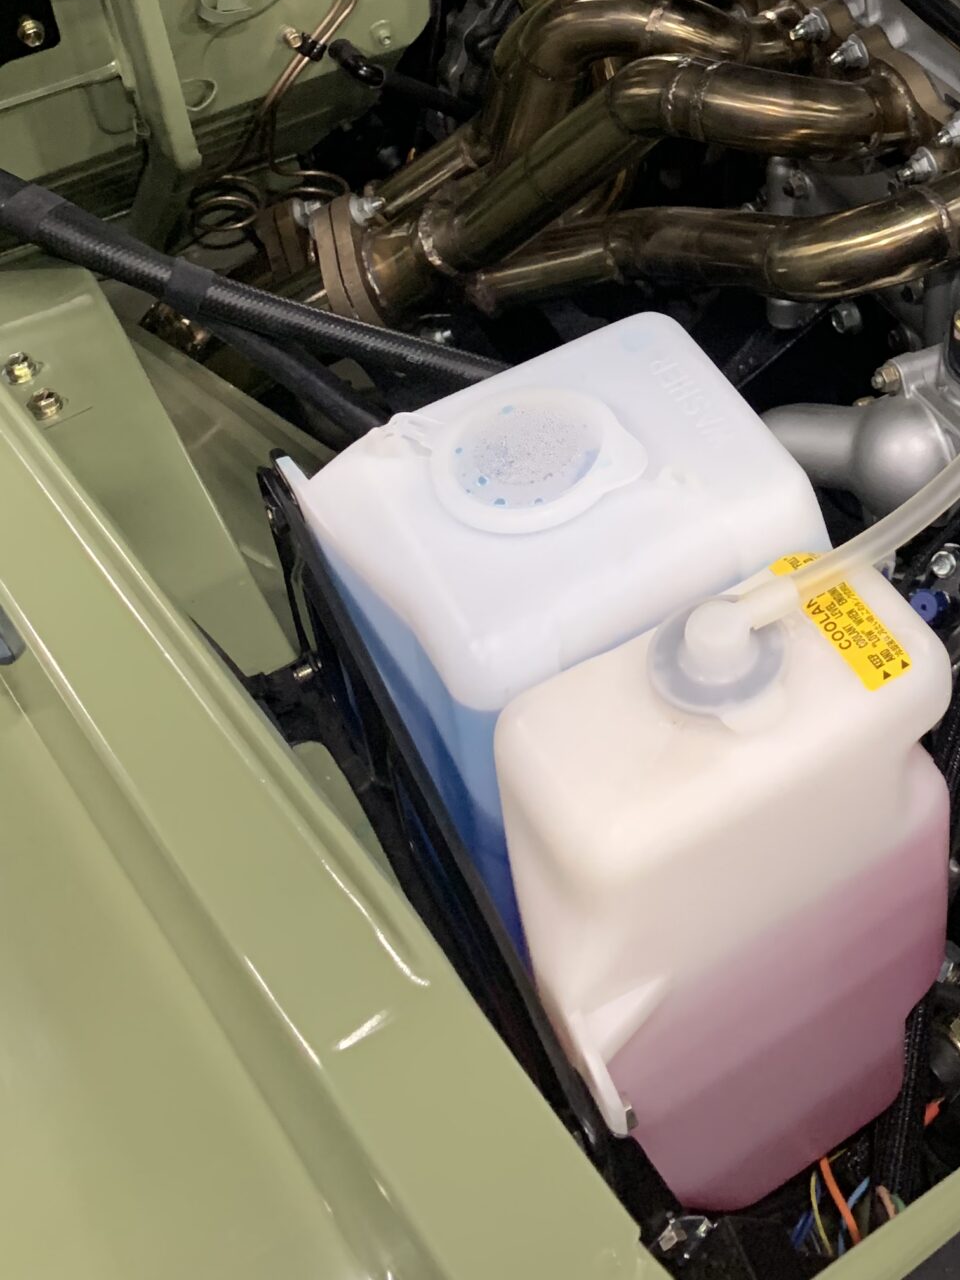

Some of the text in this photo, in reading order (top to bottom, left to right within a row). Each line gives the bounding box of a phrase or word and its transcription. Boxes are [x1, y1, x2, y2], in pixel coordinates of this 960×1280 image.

[805, 598, 853, 651] COOLAN
[846, 608, 865, 627] WHEN
[843, 623, 869, 649] COOLANT
[866, 653, 886, 670] KEEP
[879, 648, 897, 663] AND
